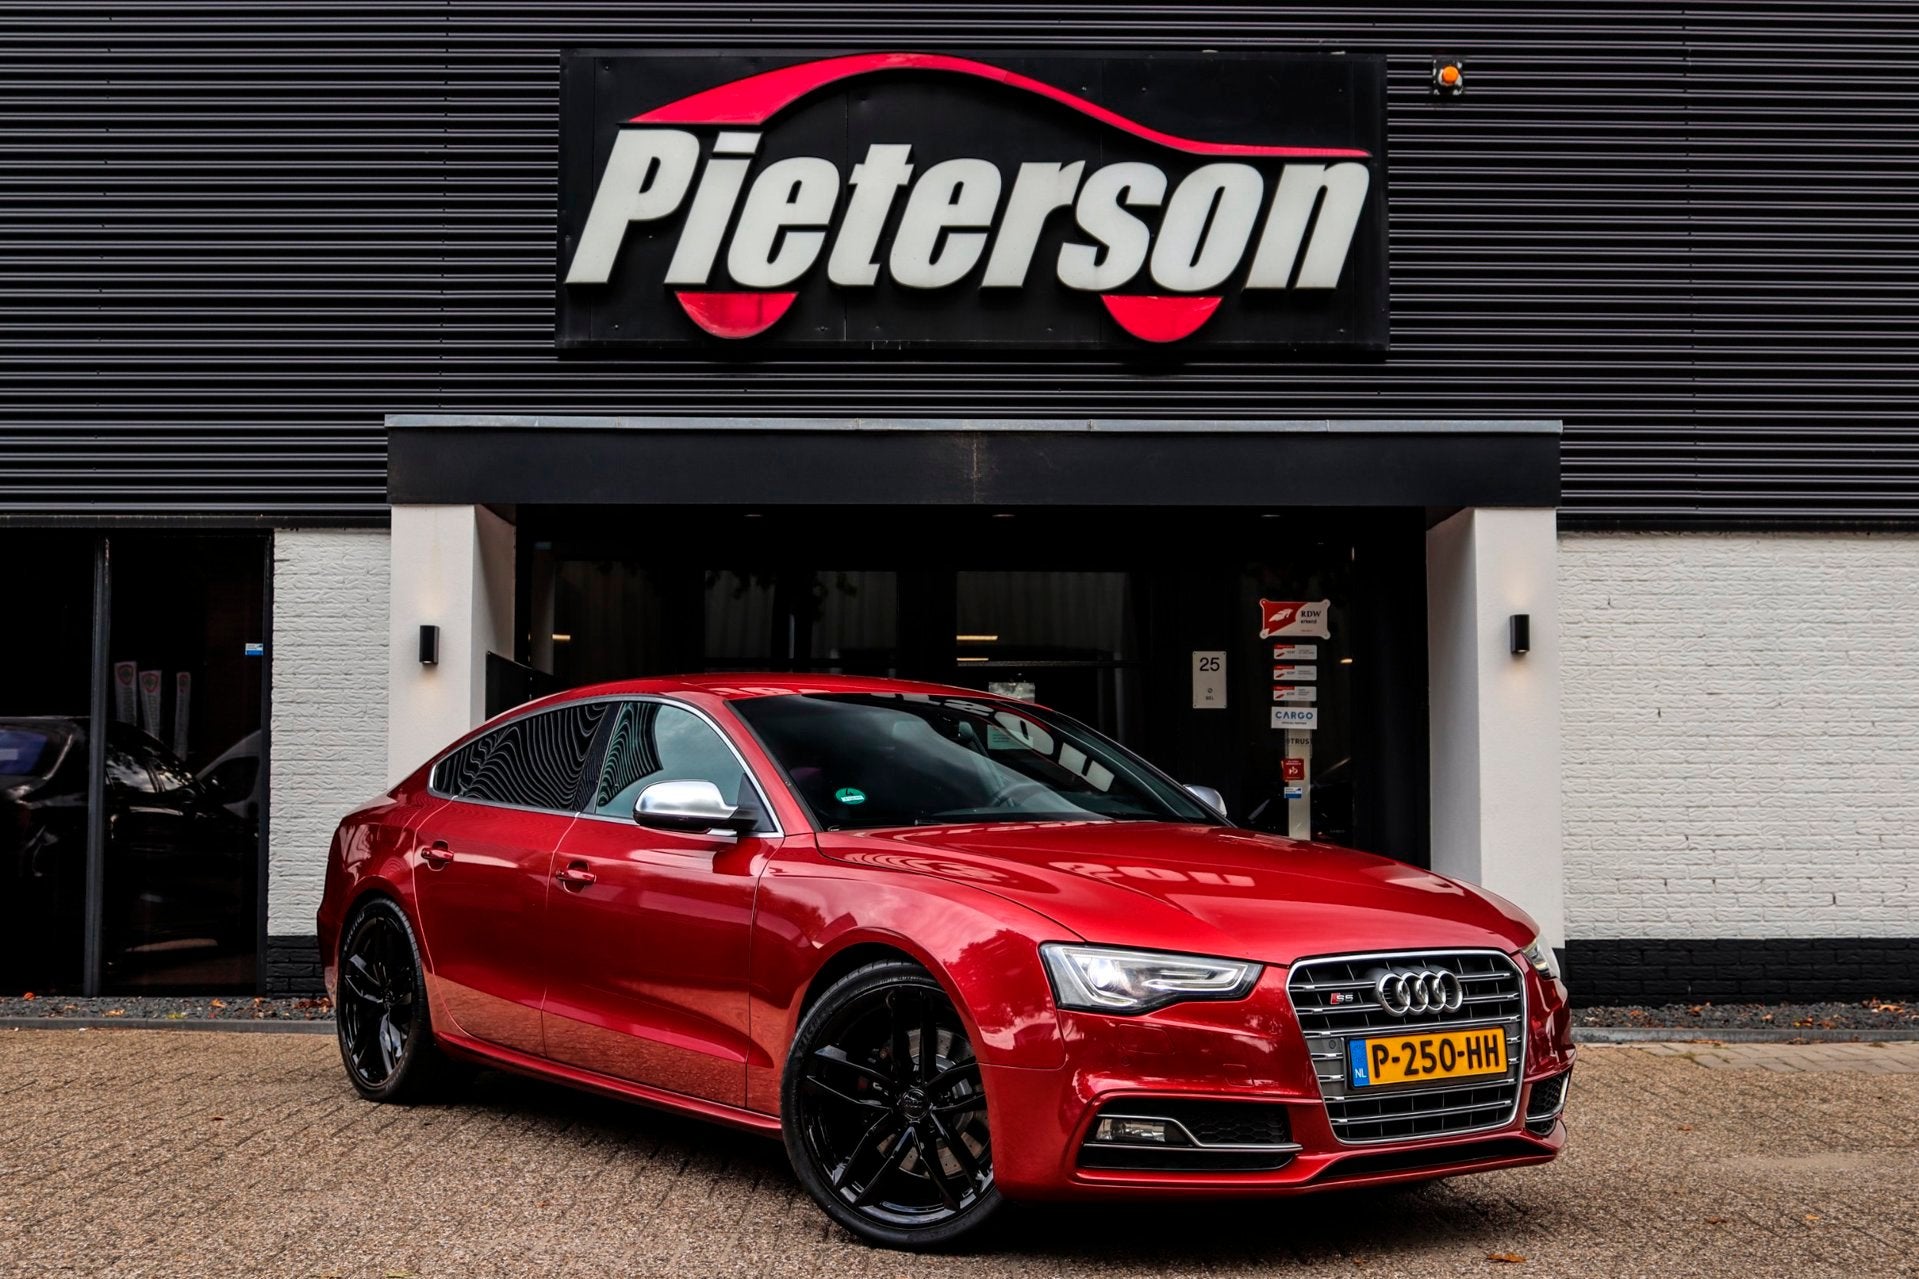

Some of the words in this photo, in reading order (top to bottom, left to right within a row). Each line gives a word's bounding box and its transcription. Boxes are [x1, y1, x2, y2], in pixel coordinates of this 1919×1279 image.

[565, 129, 1371, 292] Pieterson
[1200, 657, 1220, 671] 25
[1275, 711, 1314, 720] CARGO
[1336, 994, 1354, 1002] S5
[1371, 1034, 1500, 1079] P-250-HH
[1354, 1068, 1367, 1078] NL
